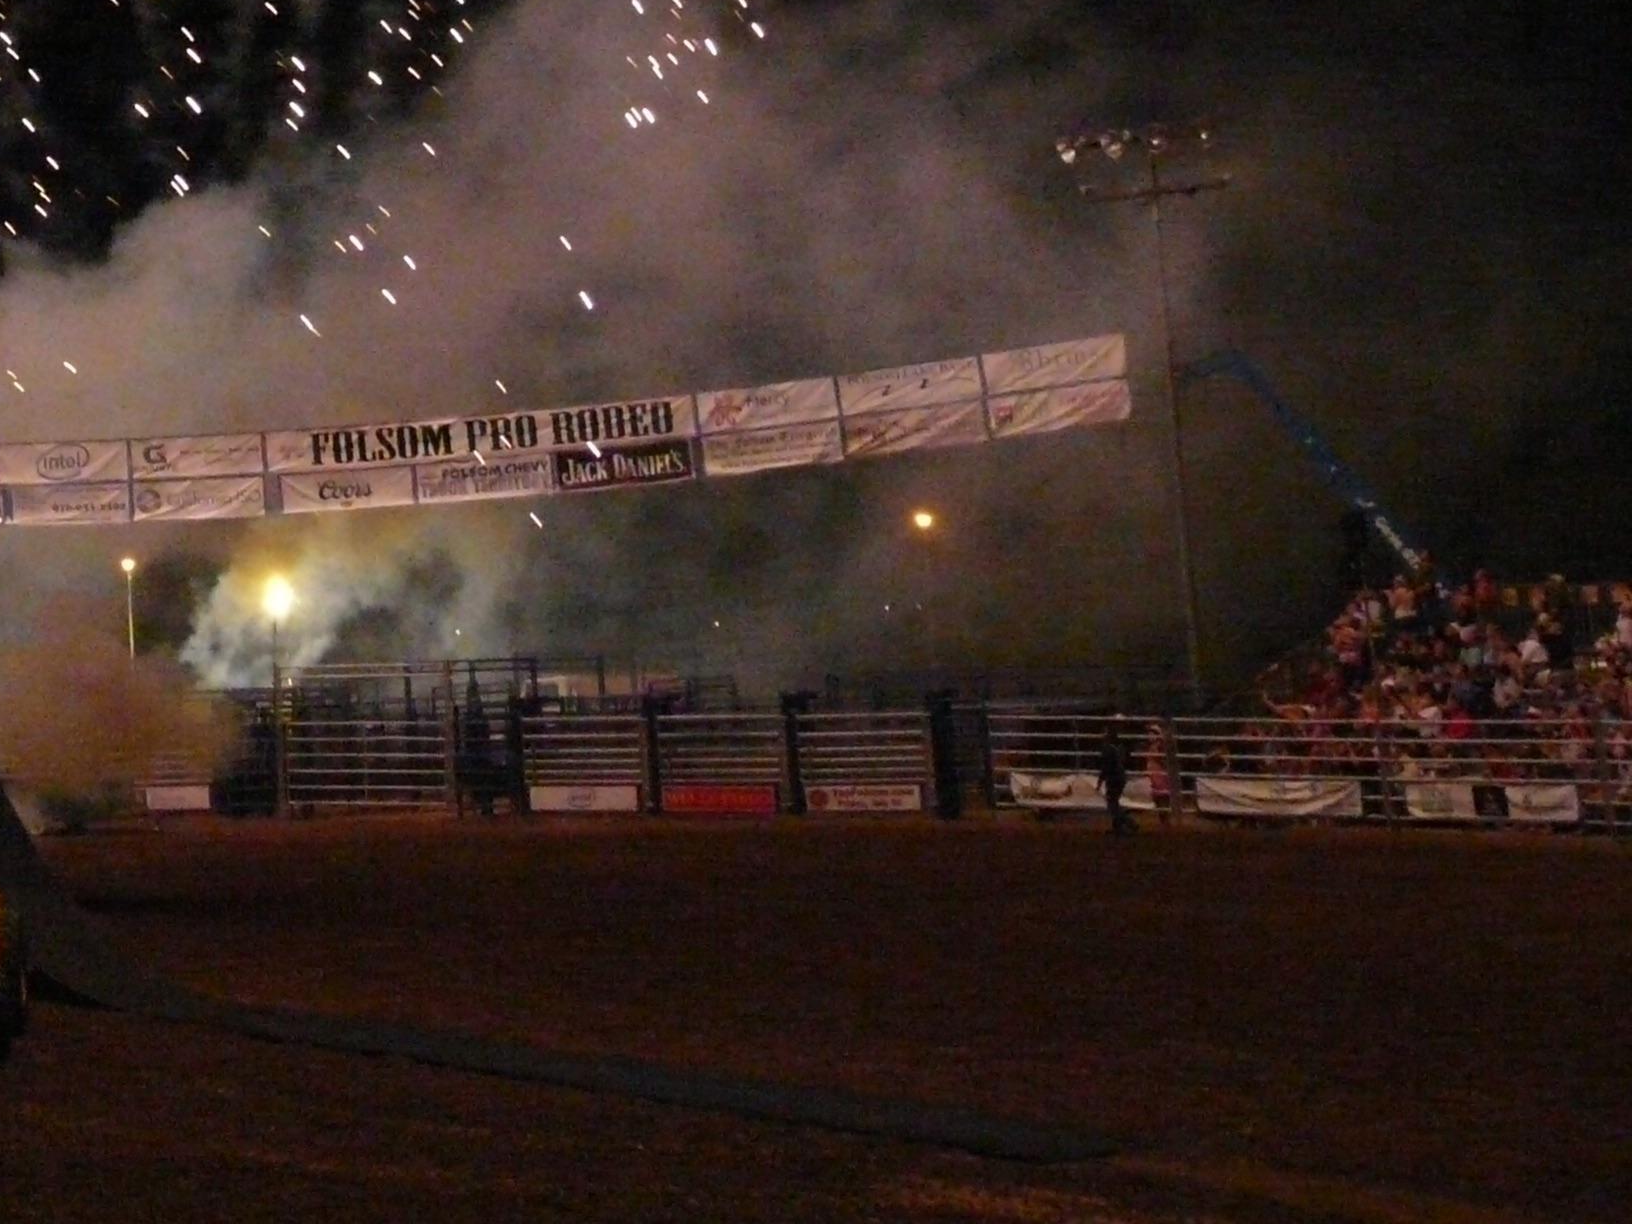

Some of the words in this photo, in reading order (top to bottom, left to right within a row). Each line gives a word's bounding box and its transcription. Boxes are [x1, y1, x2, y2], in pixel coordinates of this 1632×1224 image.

[311, 424, 453, 466] FOLSOM
[464, 415, 539, 452] PRO
[551, 402, 675, 445] RODEO
[441, 464, 502, 480] FOLSOM
[505, 460, 548, 474] CHEVY
[562, 457, 606, 485] JACK
[613, 449, 686, 479] DANIEL'S
